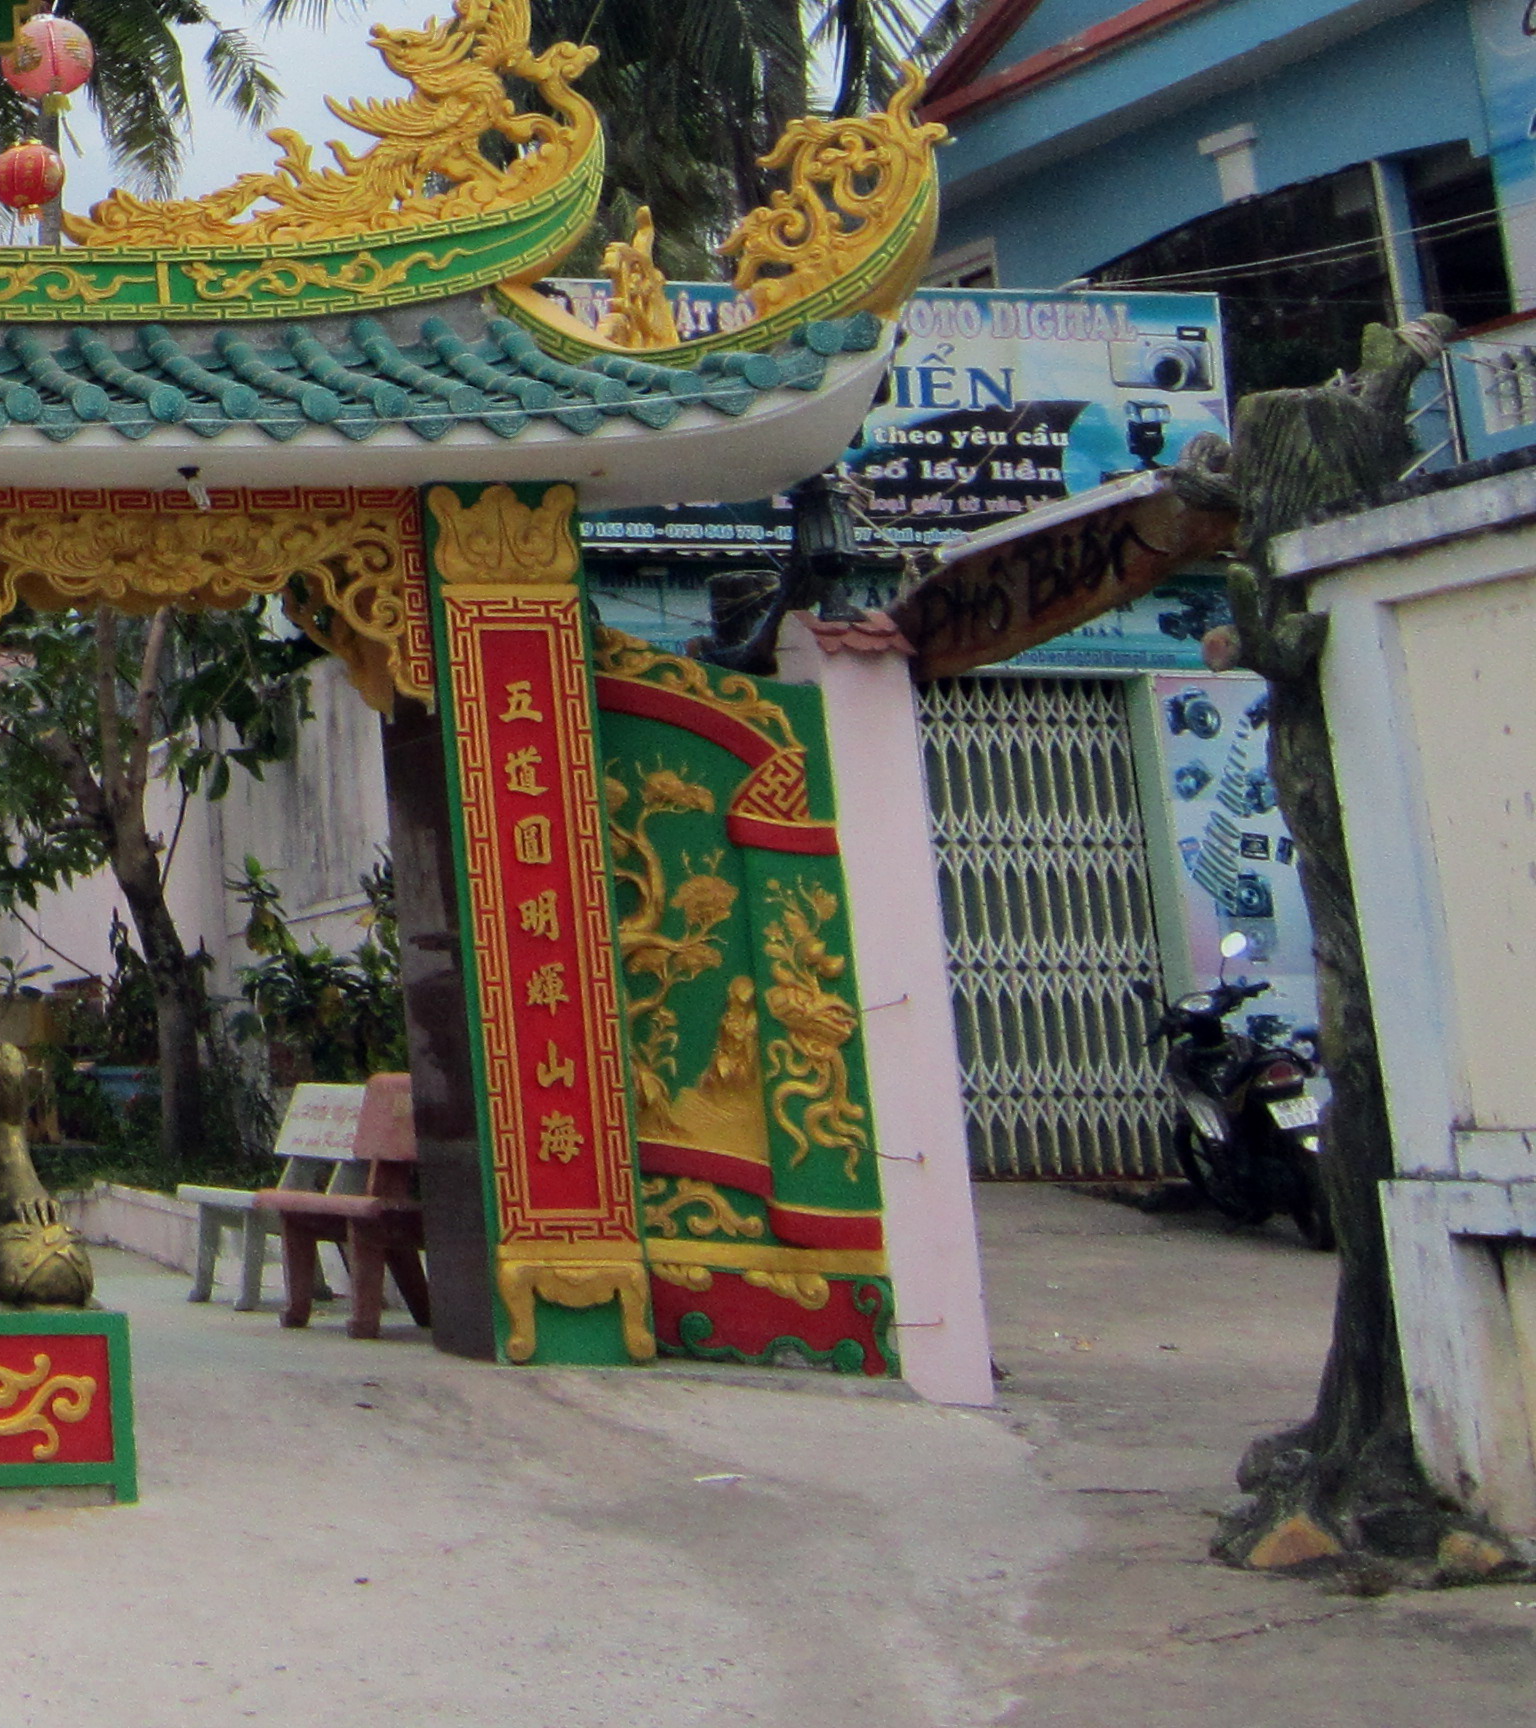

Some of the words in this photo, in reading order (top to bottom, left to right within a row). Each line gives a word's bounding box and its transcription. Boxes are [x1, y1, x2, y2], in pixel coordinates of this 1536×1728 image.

[989, 300, 1139, 343] DIGITAL
[891, 343, 1016, 411] IỂN
[873, 425, 944, 446] theo
[950, 425, 1010, 452] yêu
[1016, 422, 1069, 447] cầu
[864, 456, 909, 480] số
[920, 458, 977, 485] lấy
